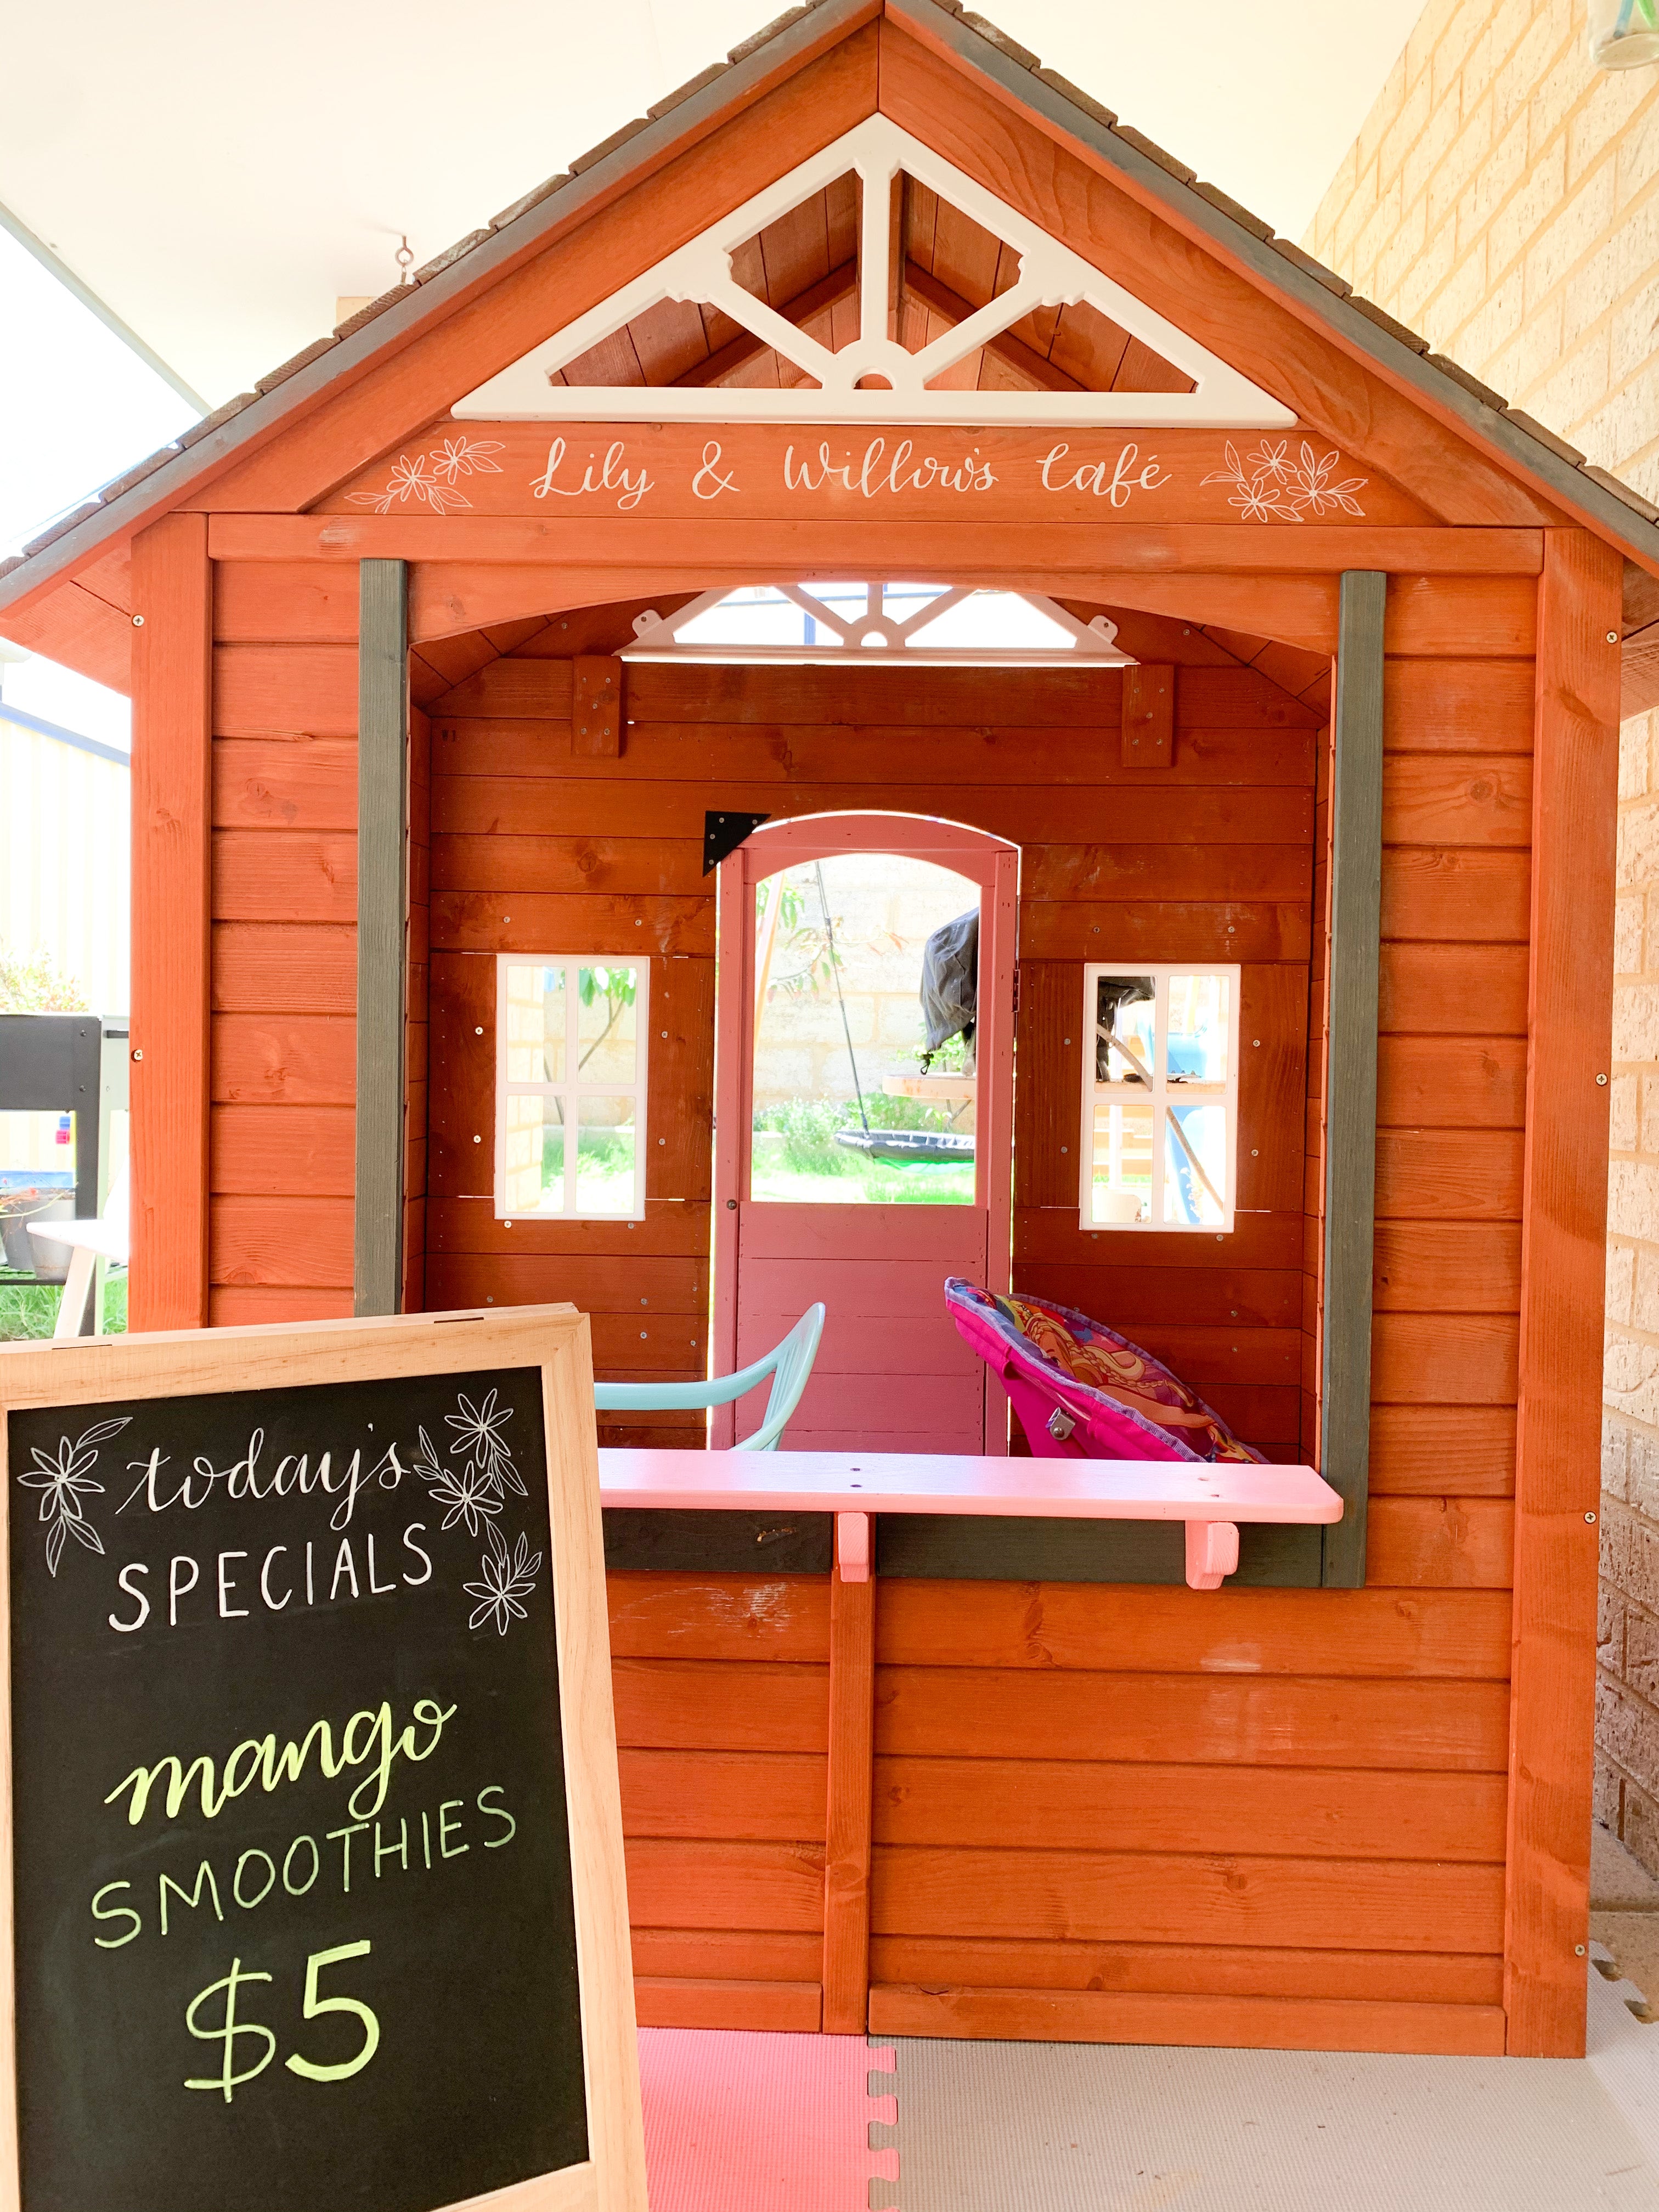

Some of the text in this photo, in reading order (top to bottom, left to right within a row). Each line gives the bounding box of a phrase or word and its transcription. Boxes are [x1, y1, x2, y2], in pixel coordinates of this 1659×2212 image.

[529, 437, 1172, 510] Lily & Willow's Café
[115, 1423, 411, 1531] today's
[109, 1522, 433, 1632] SPECIALS
[104, 1699, 458, 1825] mango
[91, 1786, 517, 1949] SMOOTHIES
[184, 1939, 381, 2104] $5
